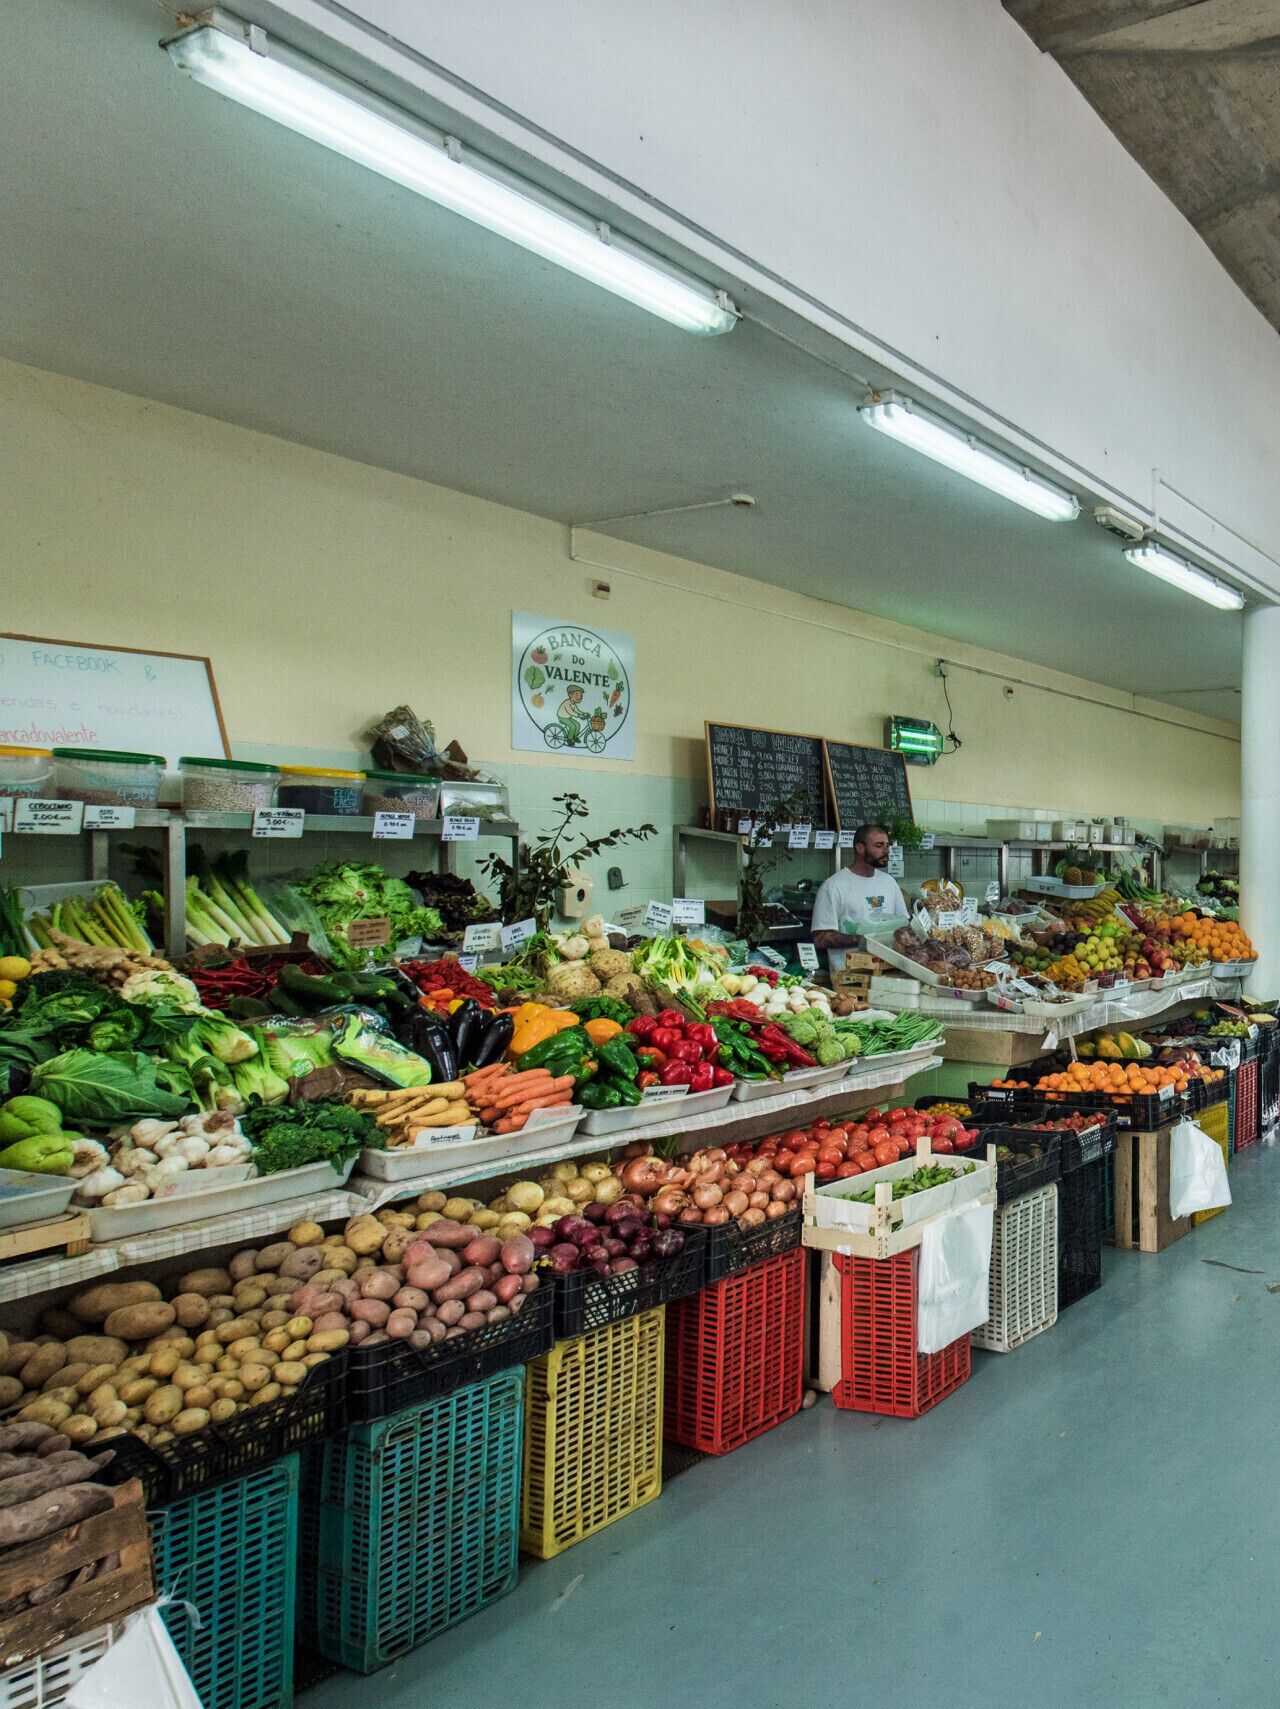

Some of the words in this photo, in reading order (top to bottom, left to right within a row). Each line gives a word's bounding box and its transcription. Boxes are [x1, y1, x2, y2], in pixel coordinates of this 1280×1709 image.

[547, 632, 602, 658] BANCA
[31, 650, 121, 673] FACEBOOK
[572, 655, 585, 666] DO
[544, 665, 610, 688] VALENTE
[0, 721, 100, 745] ancadovalente
[751, 731, 767, 748] DO
[713, 744, 733, 757] HONEY
[713, 755, 734, 768] HONEY
[716, 789, 743, 800] ALMOND
